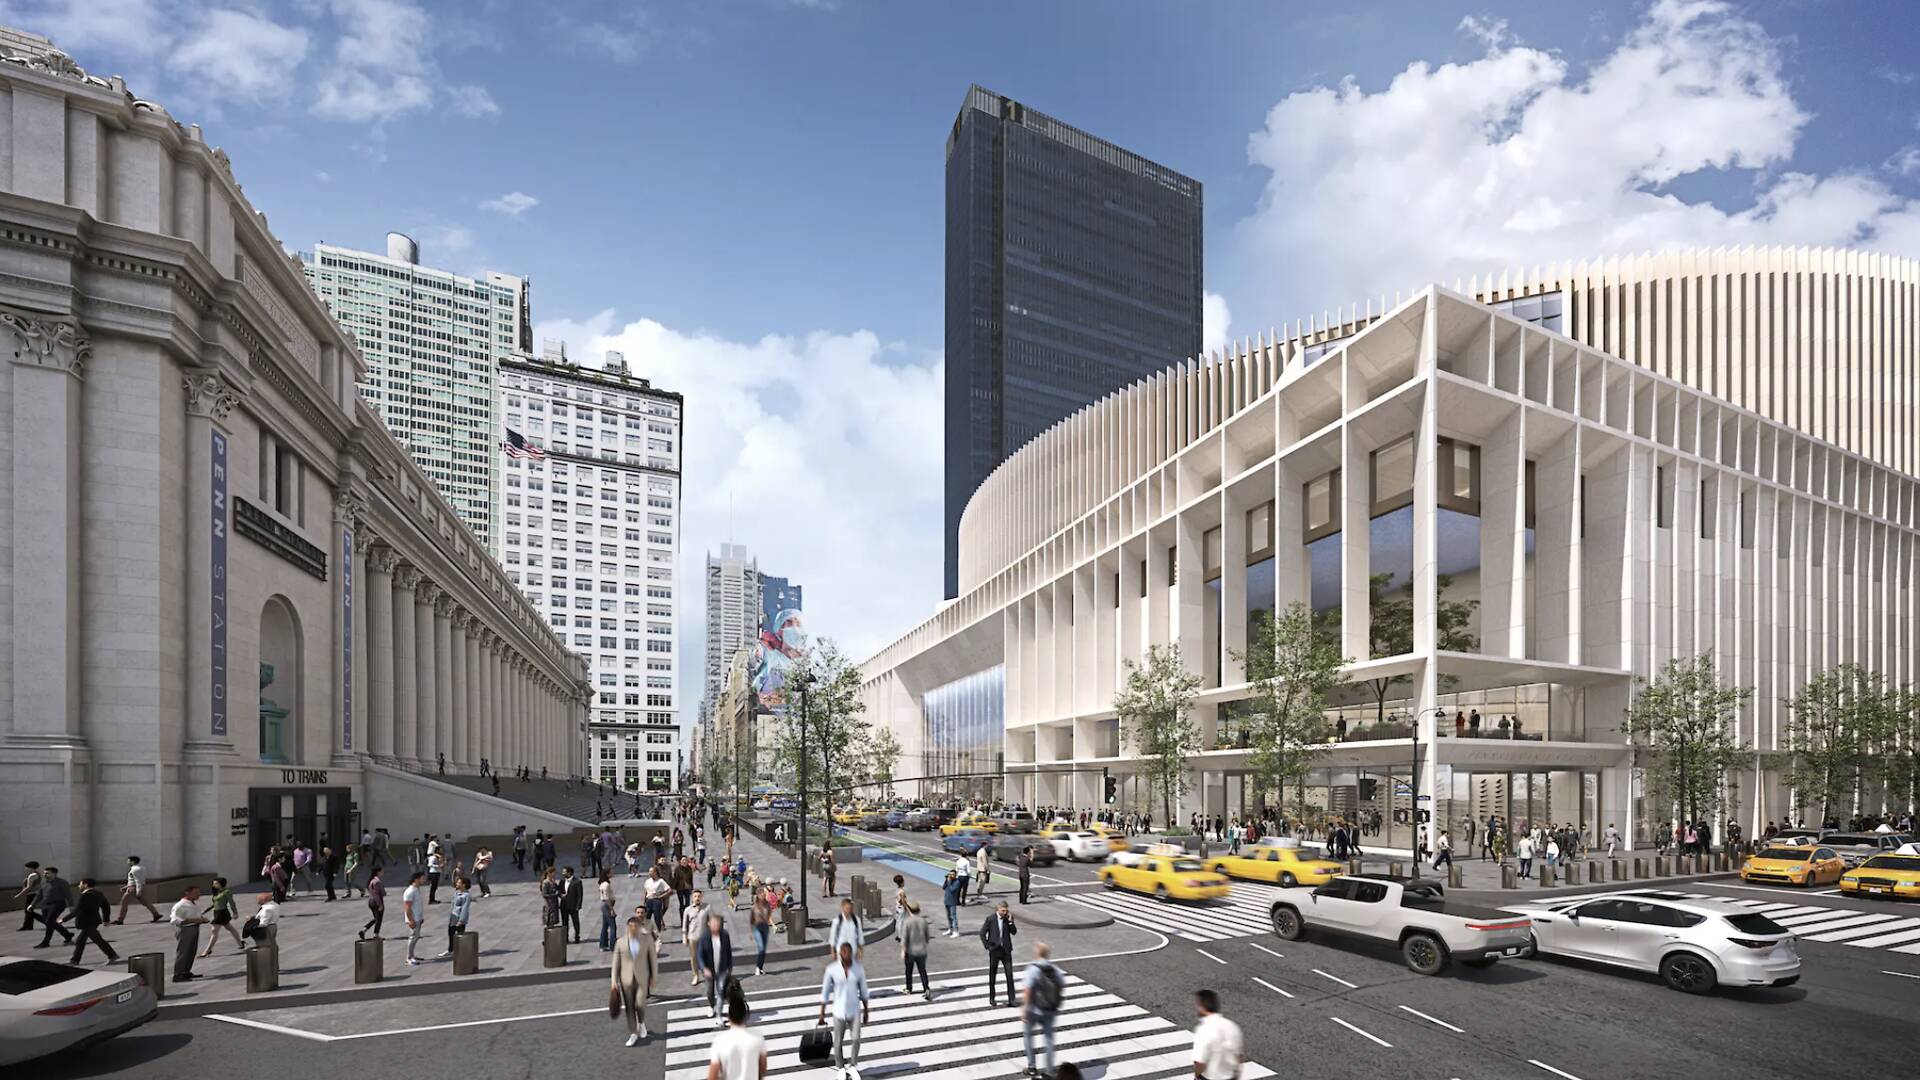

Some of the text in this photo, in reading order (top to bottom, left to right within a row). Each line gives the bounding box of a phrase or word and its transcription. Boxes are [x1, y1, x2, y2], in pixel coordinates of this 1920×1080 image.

[1006, 100, 1016, 121] 1
[214, 435, 225, 731] PENN STATION
[281, 769, 328, 785] TO TRAINS
[231, 807, 249, 820] LIRR
